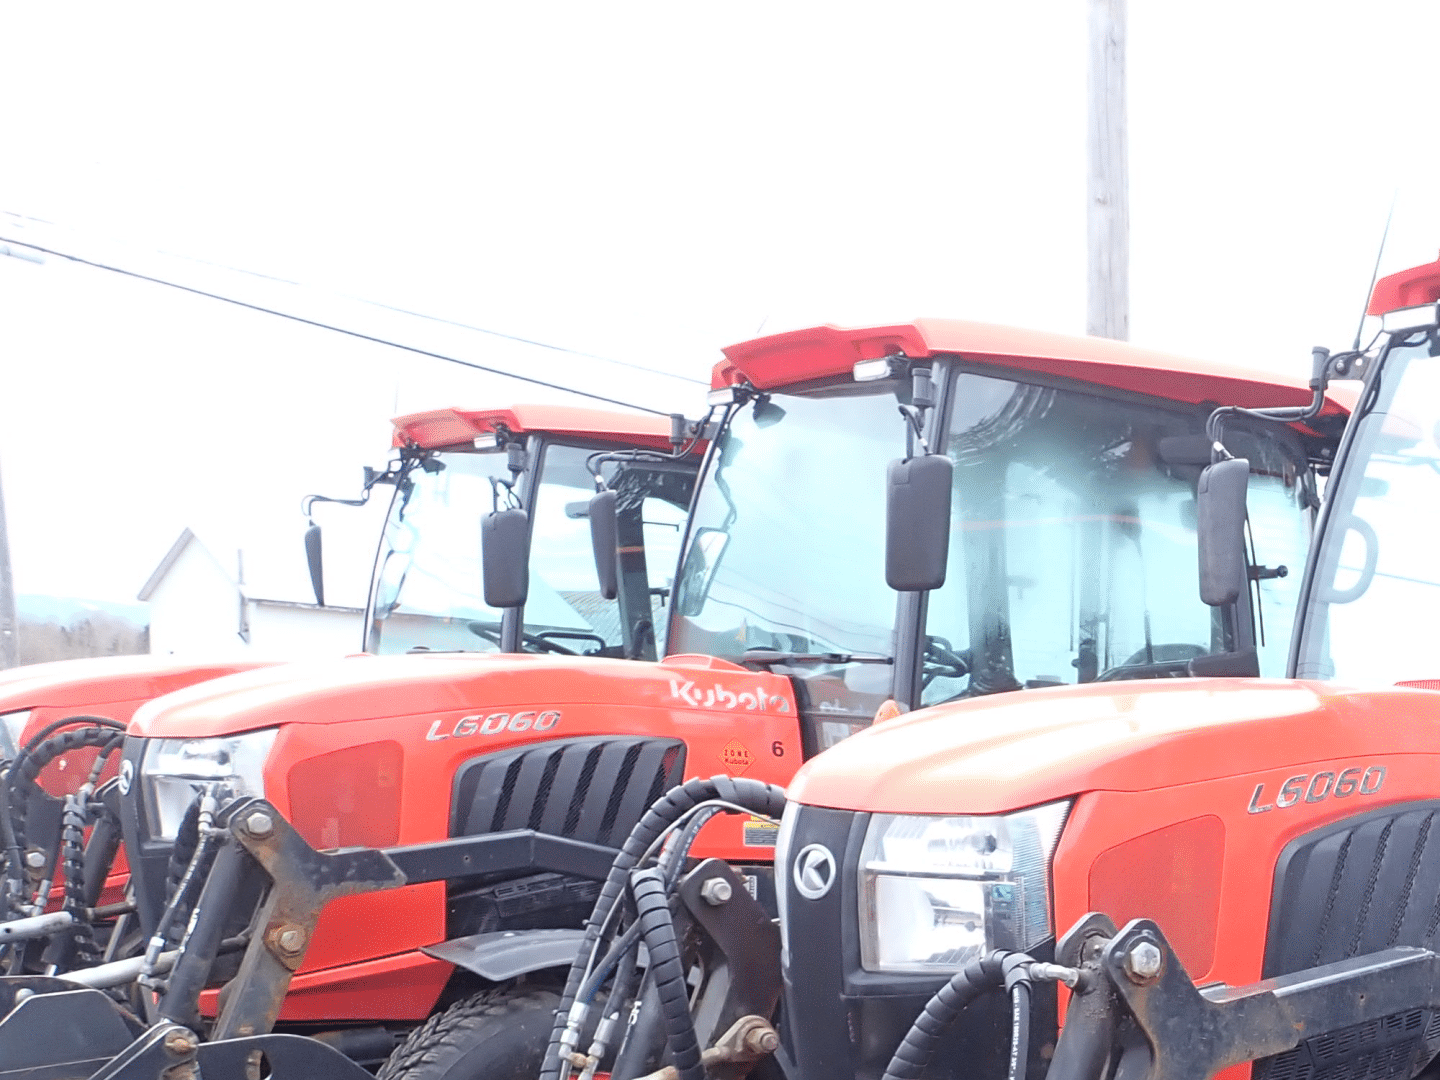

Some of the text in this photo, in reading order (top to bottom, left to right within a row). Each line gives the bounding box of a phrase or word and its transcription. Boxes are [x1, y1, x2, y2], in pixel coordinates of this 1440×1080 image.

[669, 679, 789, 713] Kubota
[425, 711, 561, 742] L6060
[771, 740, 785, 758] 6
[1247, 765, 1387, 815] L6060
